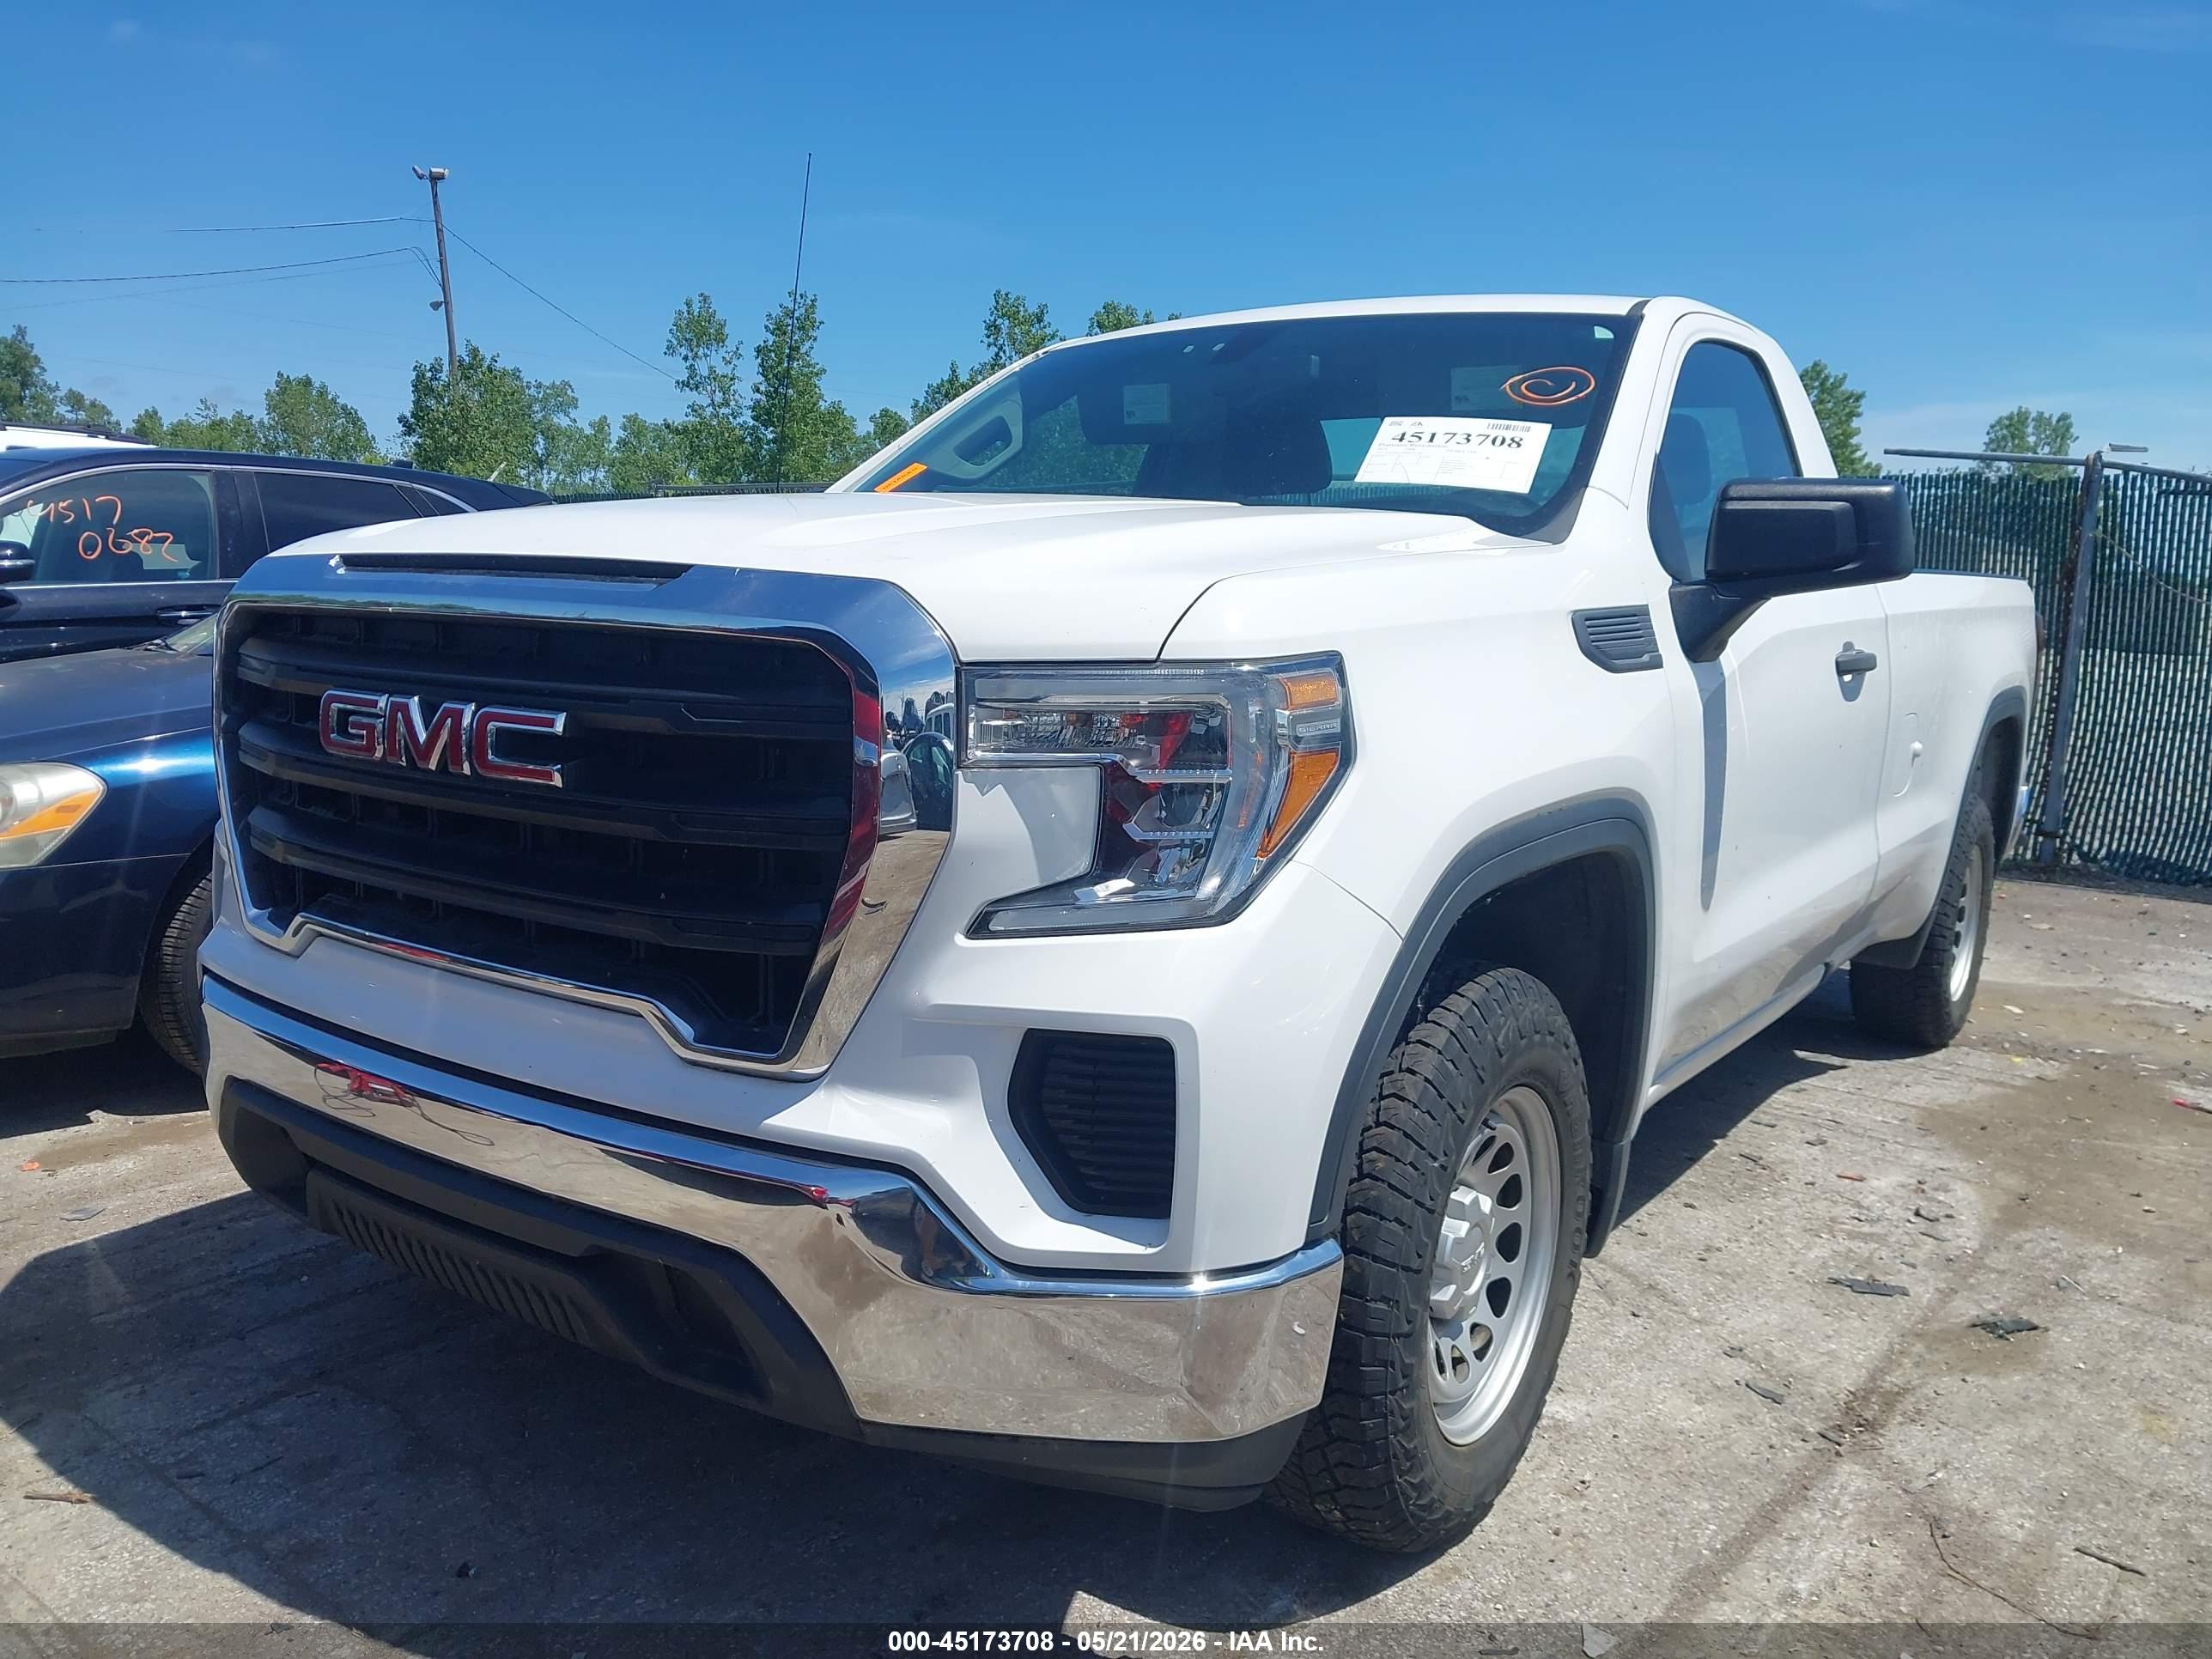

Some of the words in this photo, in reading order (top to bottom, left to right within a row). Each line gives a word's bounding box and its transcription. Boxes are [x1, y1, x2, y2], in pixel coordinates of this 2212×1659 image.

[1391, 430, 1523, 450] 45173708
[78, 527, 179, 562] 0682
[319, 689, 568, 789] GMC
